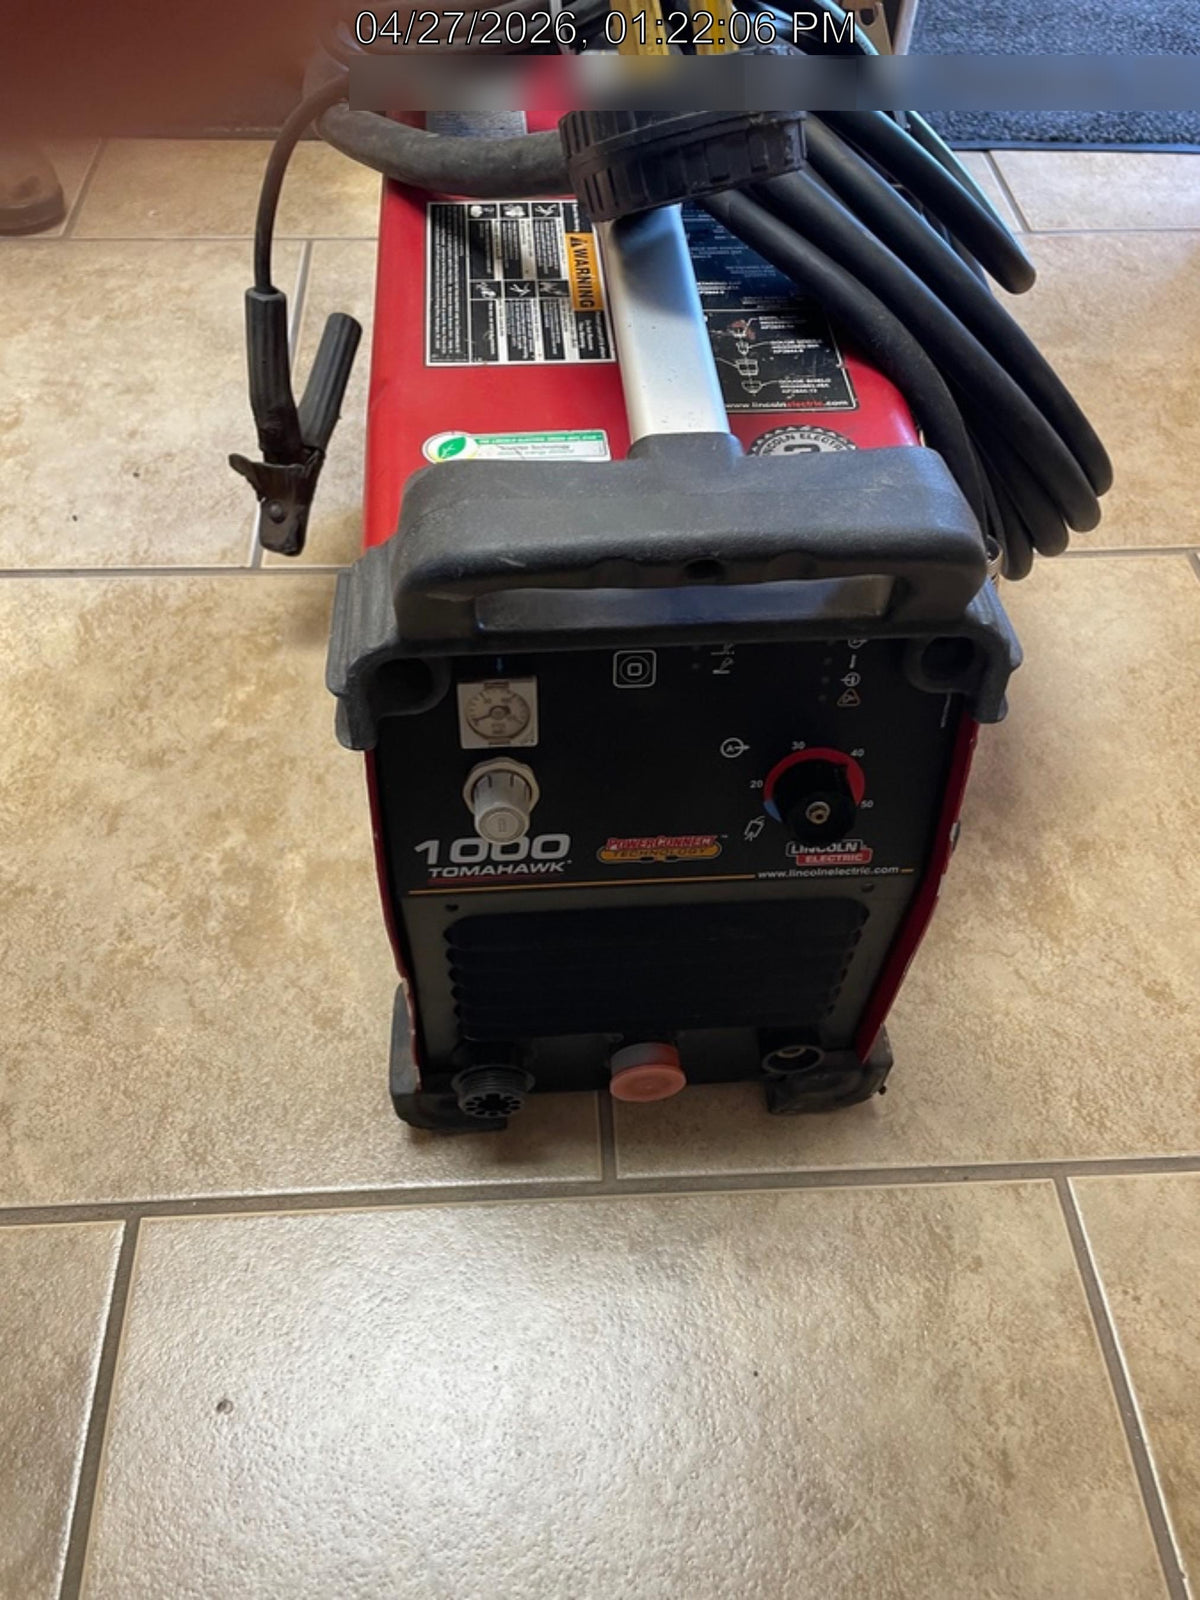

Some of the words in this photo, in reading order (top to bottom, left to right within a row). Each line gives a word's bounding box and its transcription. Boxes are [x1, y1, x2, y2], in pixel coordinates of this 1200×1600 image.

[573, 248, 596, 308] WARNING
[791, 741, 806, 750] 30
[851, 748, 865, 757] 40
[750, 780, 763, 788] 20
[861, 800, 874, 808] 50
[414, 833, 571, 865] 1000
[805, 853, 863, 863] ELECTRIC
[428, 861, 566, 877] TOMAHAWK
[758, 866, 899, 878] www.lincolnelectric.com
